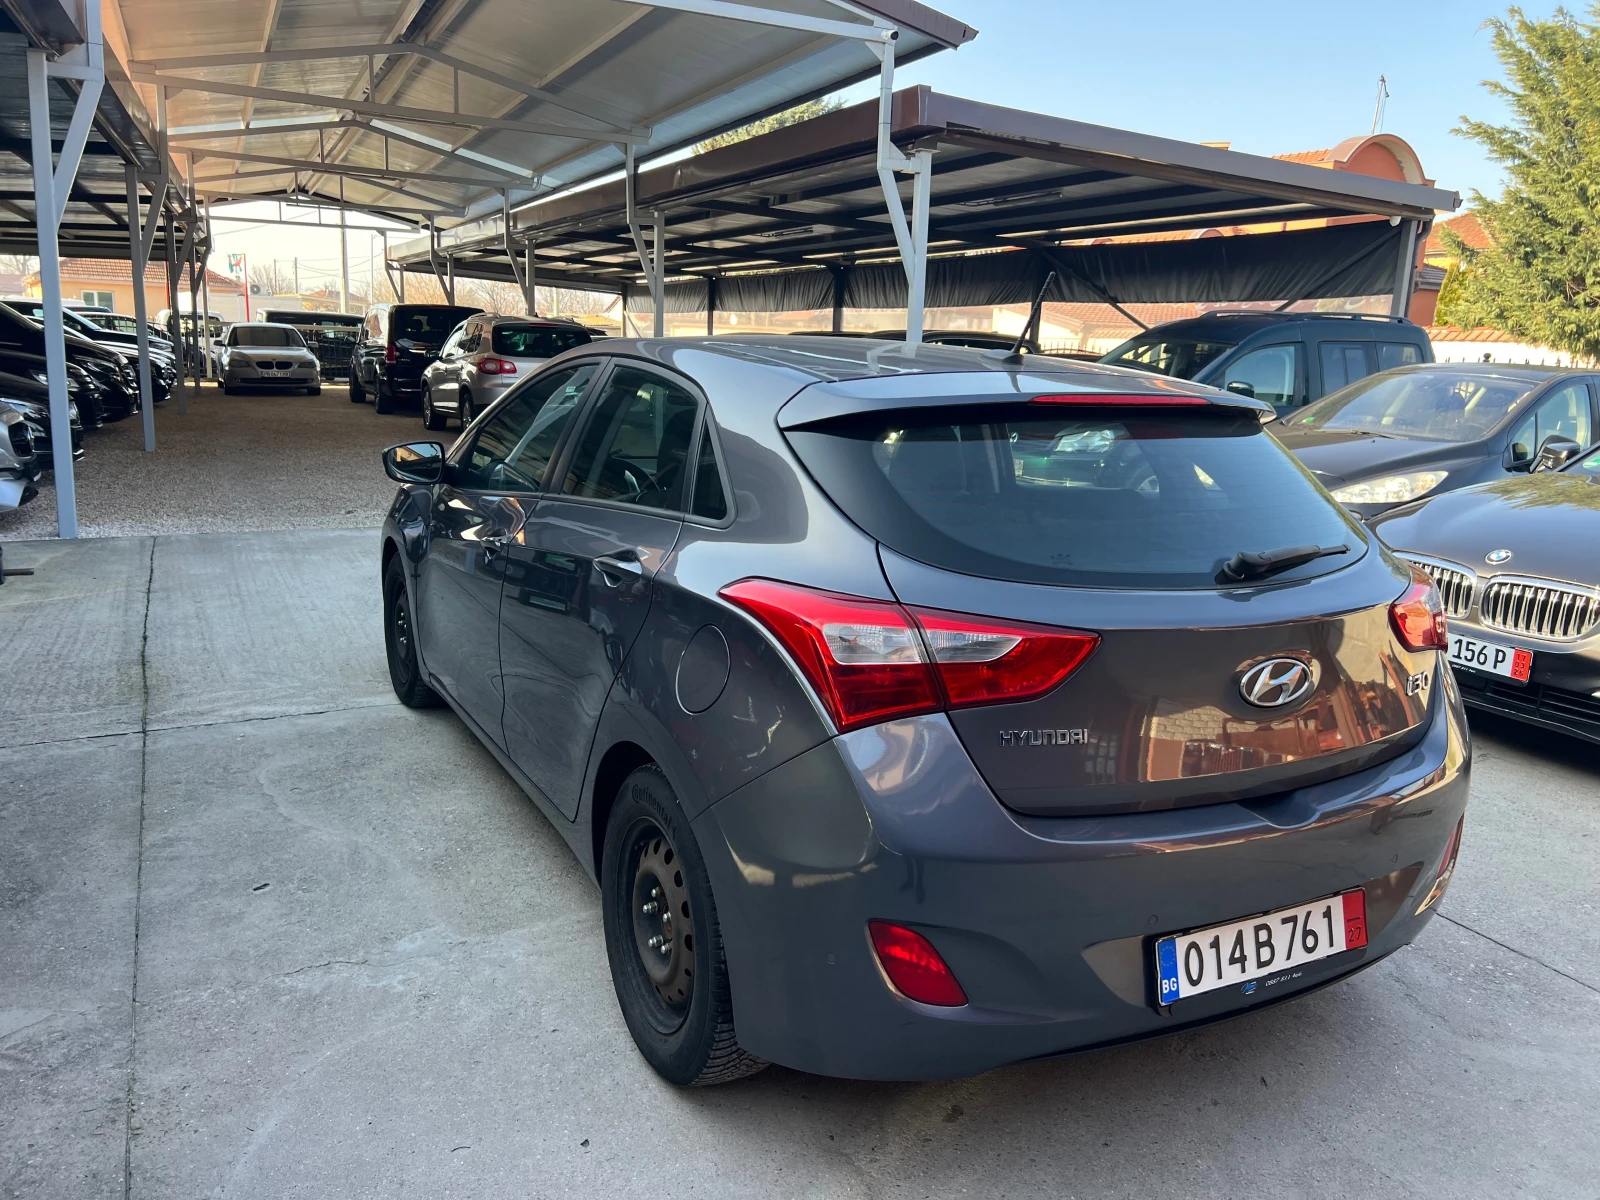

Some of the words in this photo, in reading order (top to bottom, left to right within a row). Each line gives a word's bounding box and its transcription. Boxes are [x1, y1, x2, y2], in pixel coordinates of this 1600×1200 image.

[1452, 638, 1488, 666] 156
[1493, 648, 1507, 670] P
[1404, 671, 1430, 697] i30
[999, 728, 1088, 747] HYUNDAI
[631, 783, 673, 831] Continental
[1347, 925, 1362, 942] 27
[1161, 977, 1178, 994] BG
